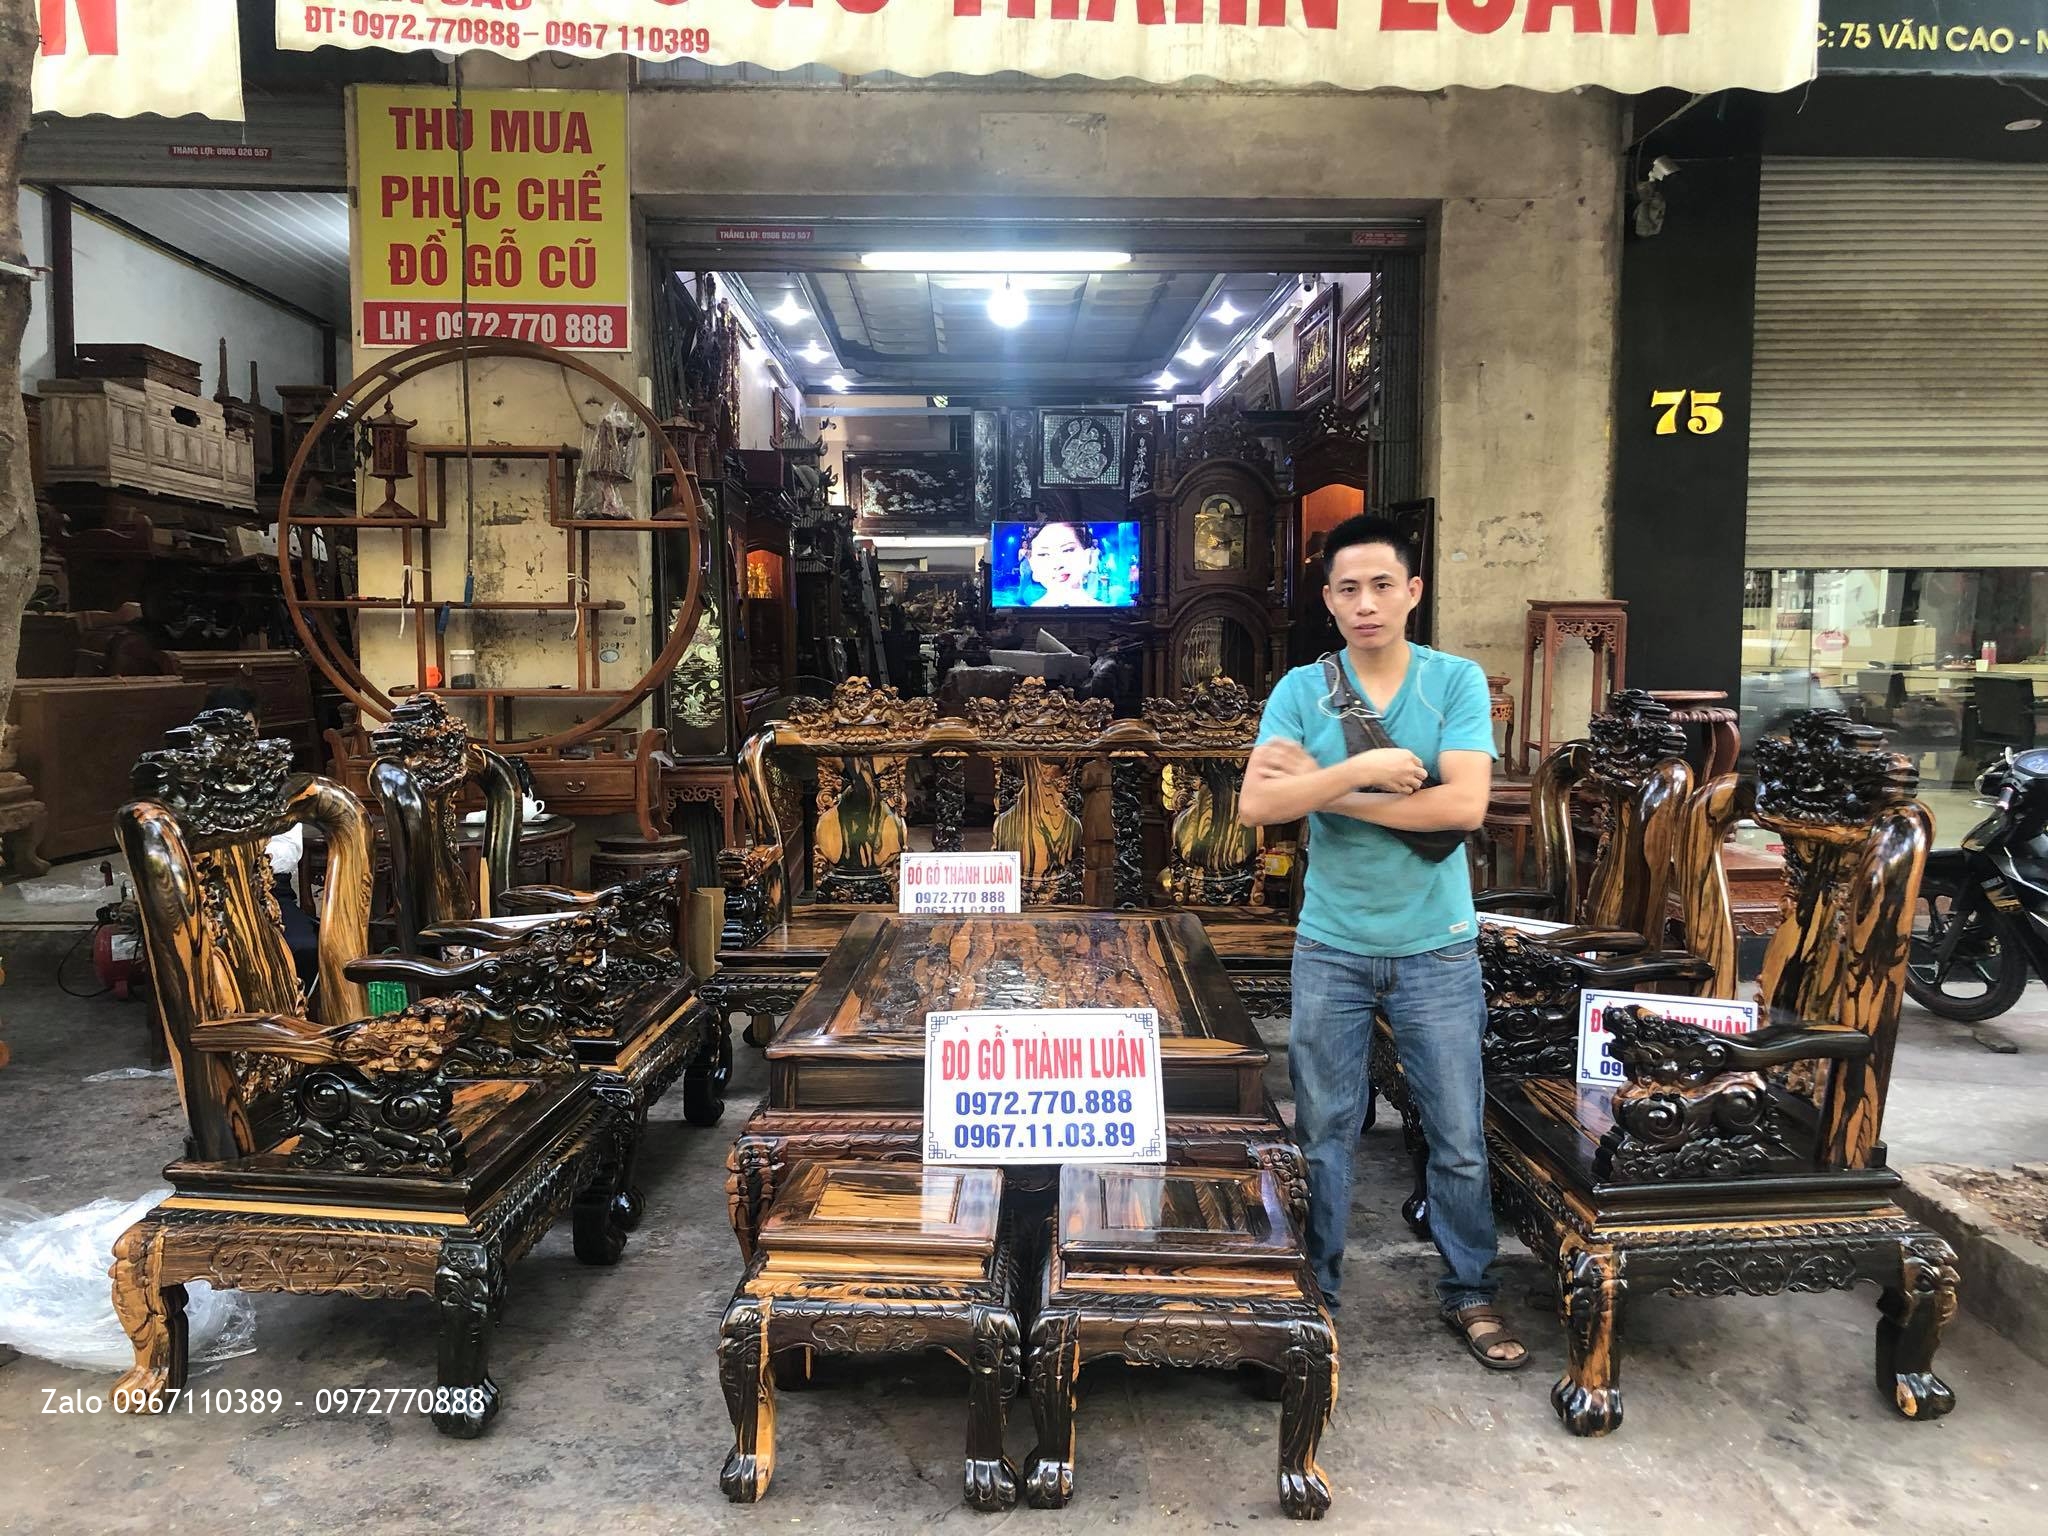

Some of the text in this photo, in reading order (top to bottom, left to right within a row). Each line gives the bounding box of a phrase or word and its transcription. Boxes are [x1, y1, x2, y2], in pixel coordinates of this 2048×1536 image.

[545, 21, 608, 49] 0967
[617, 25, 710, 54] 110389
[1840, 22, 1872, 49] 75
[1878, 17, 1938, 50] VĂN
[1945, 26, 2014, 54] CAO
[490, 109, 593, 154] MUA
[381, 164, 607, 229] PHỤC CHẾ
[388, 228, 597, 289] ĐỒ GỖ CŨ
[379, 310, 411, 340] LH
[565, 313, 614, 344] 888
[1650, 389, 1723, 435] 75
[981, 890, 1005, 903] 888
[978, 1024, 1005, 1080] GỖ
[1012, 1032, 1083, 1080] THÀNH
[1090, 1030, 1146, 1078] LUÂN
[955, 1089, 1132, 1116] 0972.770.888
[954, 1122, 1135, 1148] 0967.11.03.89
